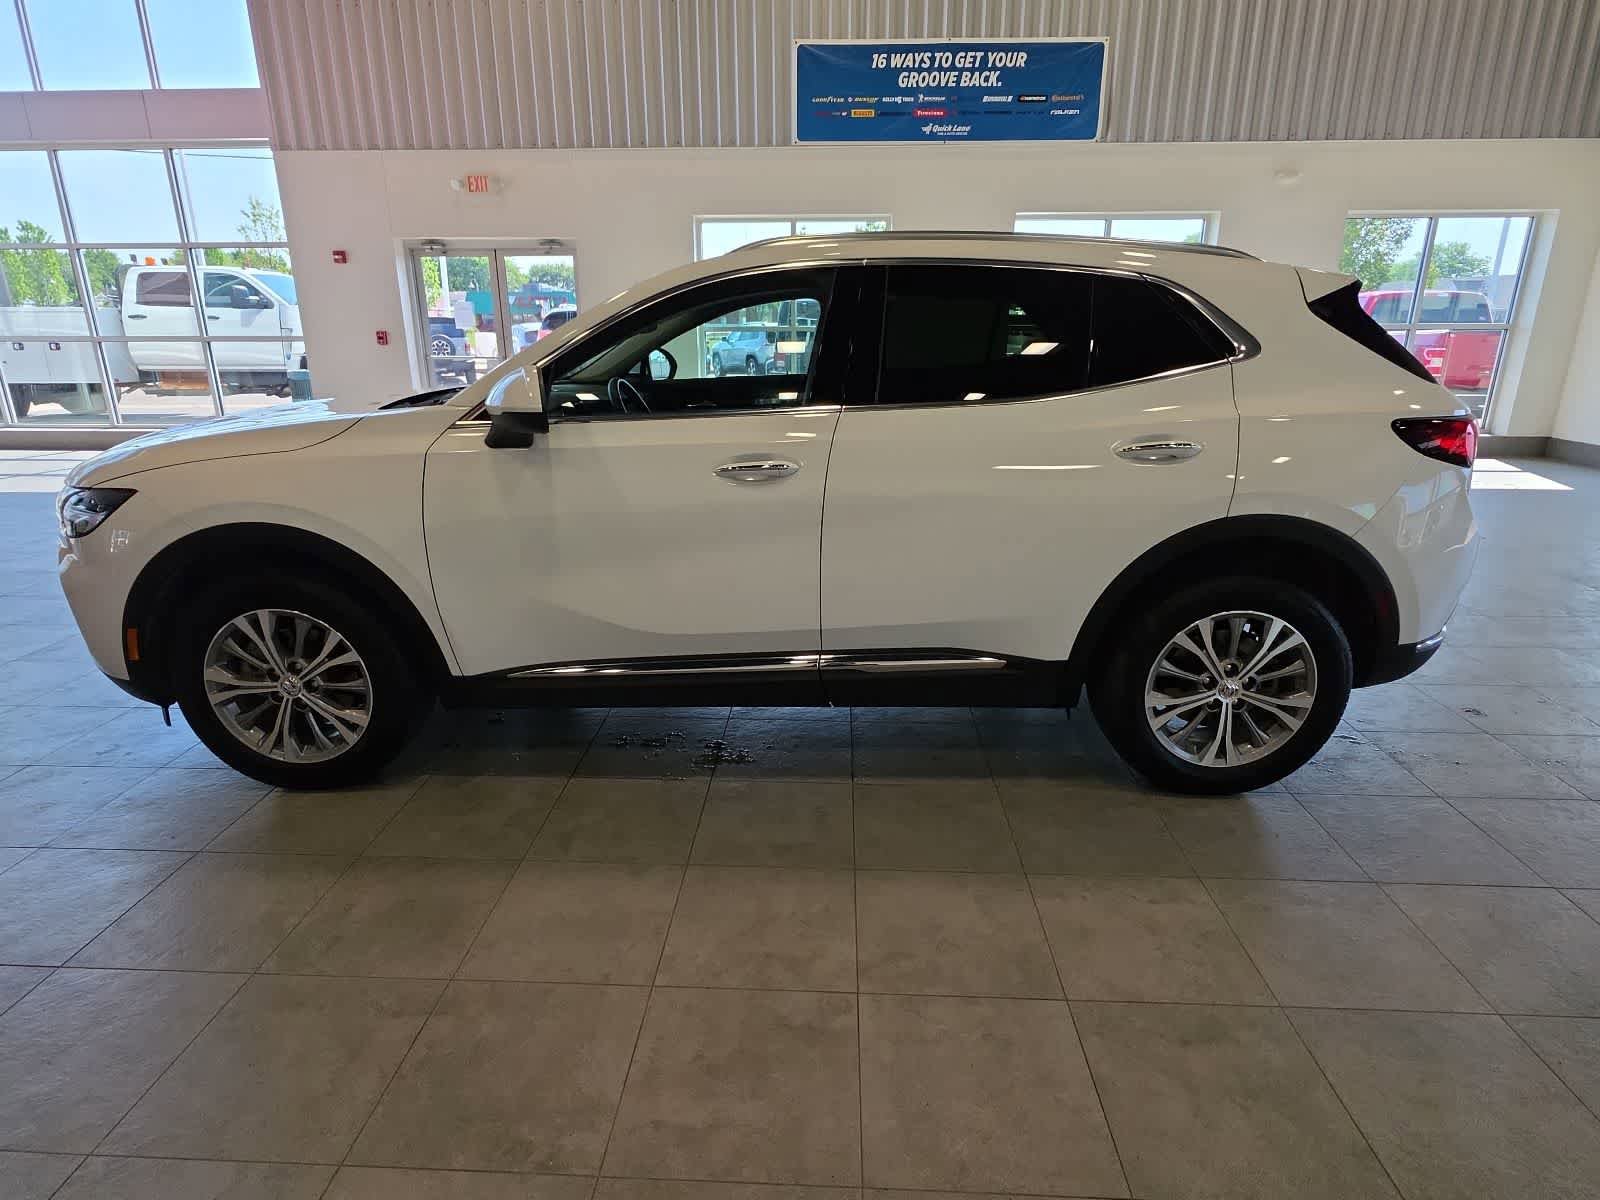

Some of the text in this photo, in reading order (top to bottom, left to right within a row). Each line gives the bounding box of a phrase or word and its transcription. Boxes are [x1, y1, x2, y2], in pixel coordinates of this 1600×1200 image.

[871, 51, 1028, 69] 16 WAYS TO GET YOUR
[898, 70, 1002, 88] GROOVE BACK.
[932, 124, 972, 133] Quick Lane
[467, 175, 489, 193] EXIT
